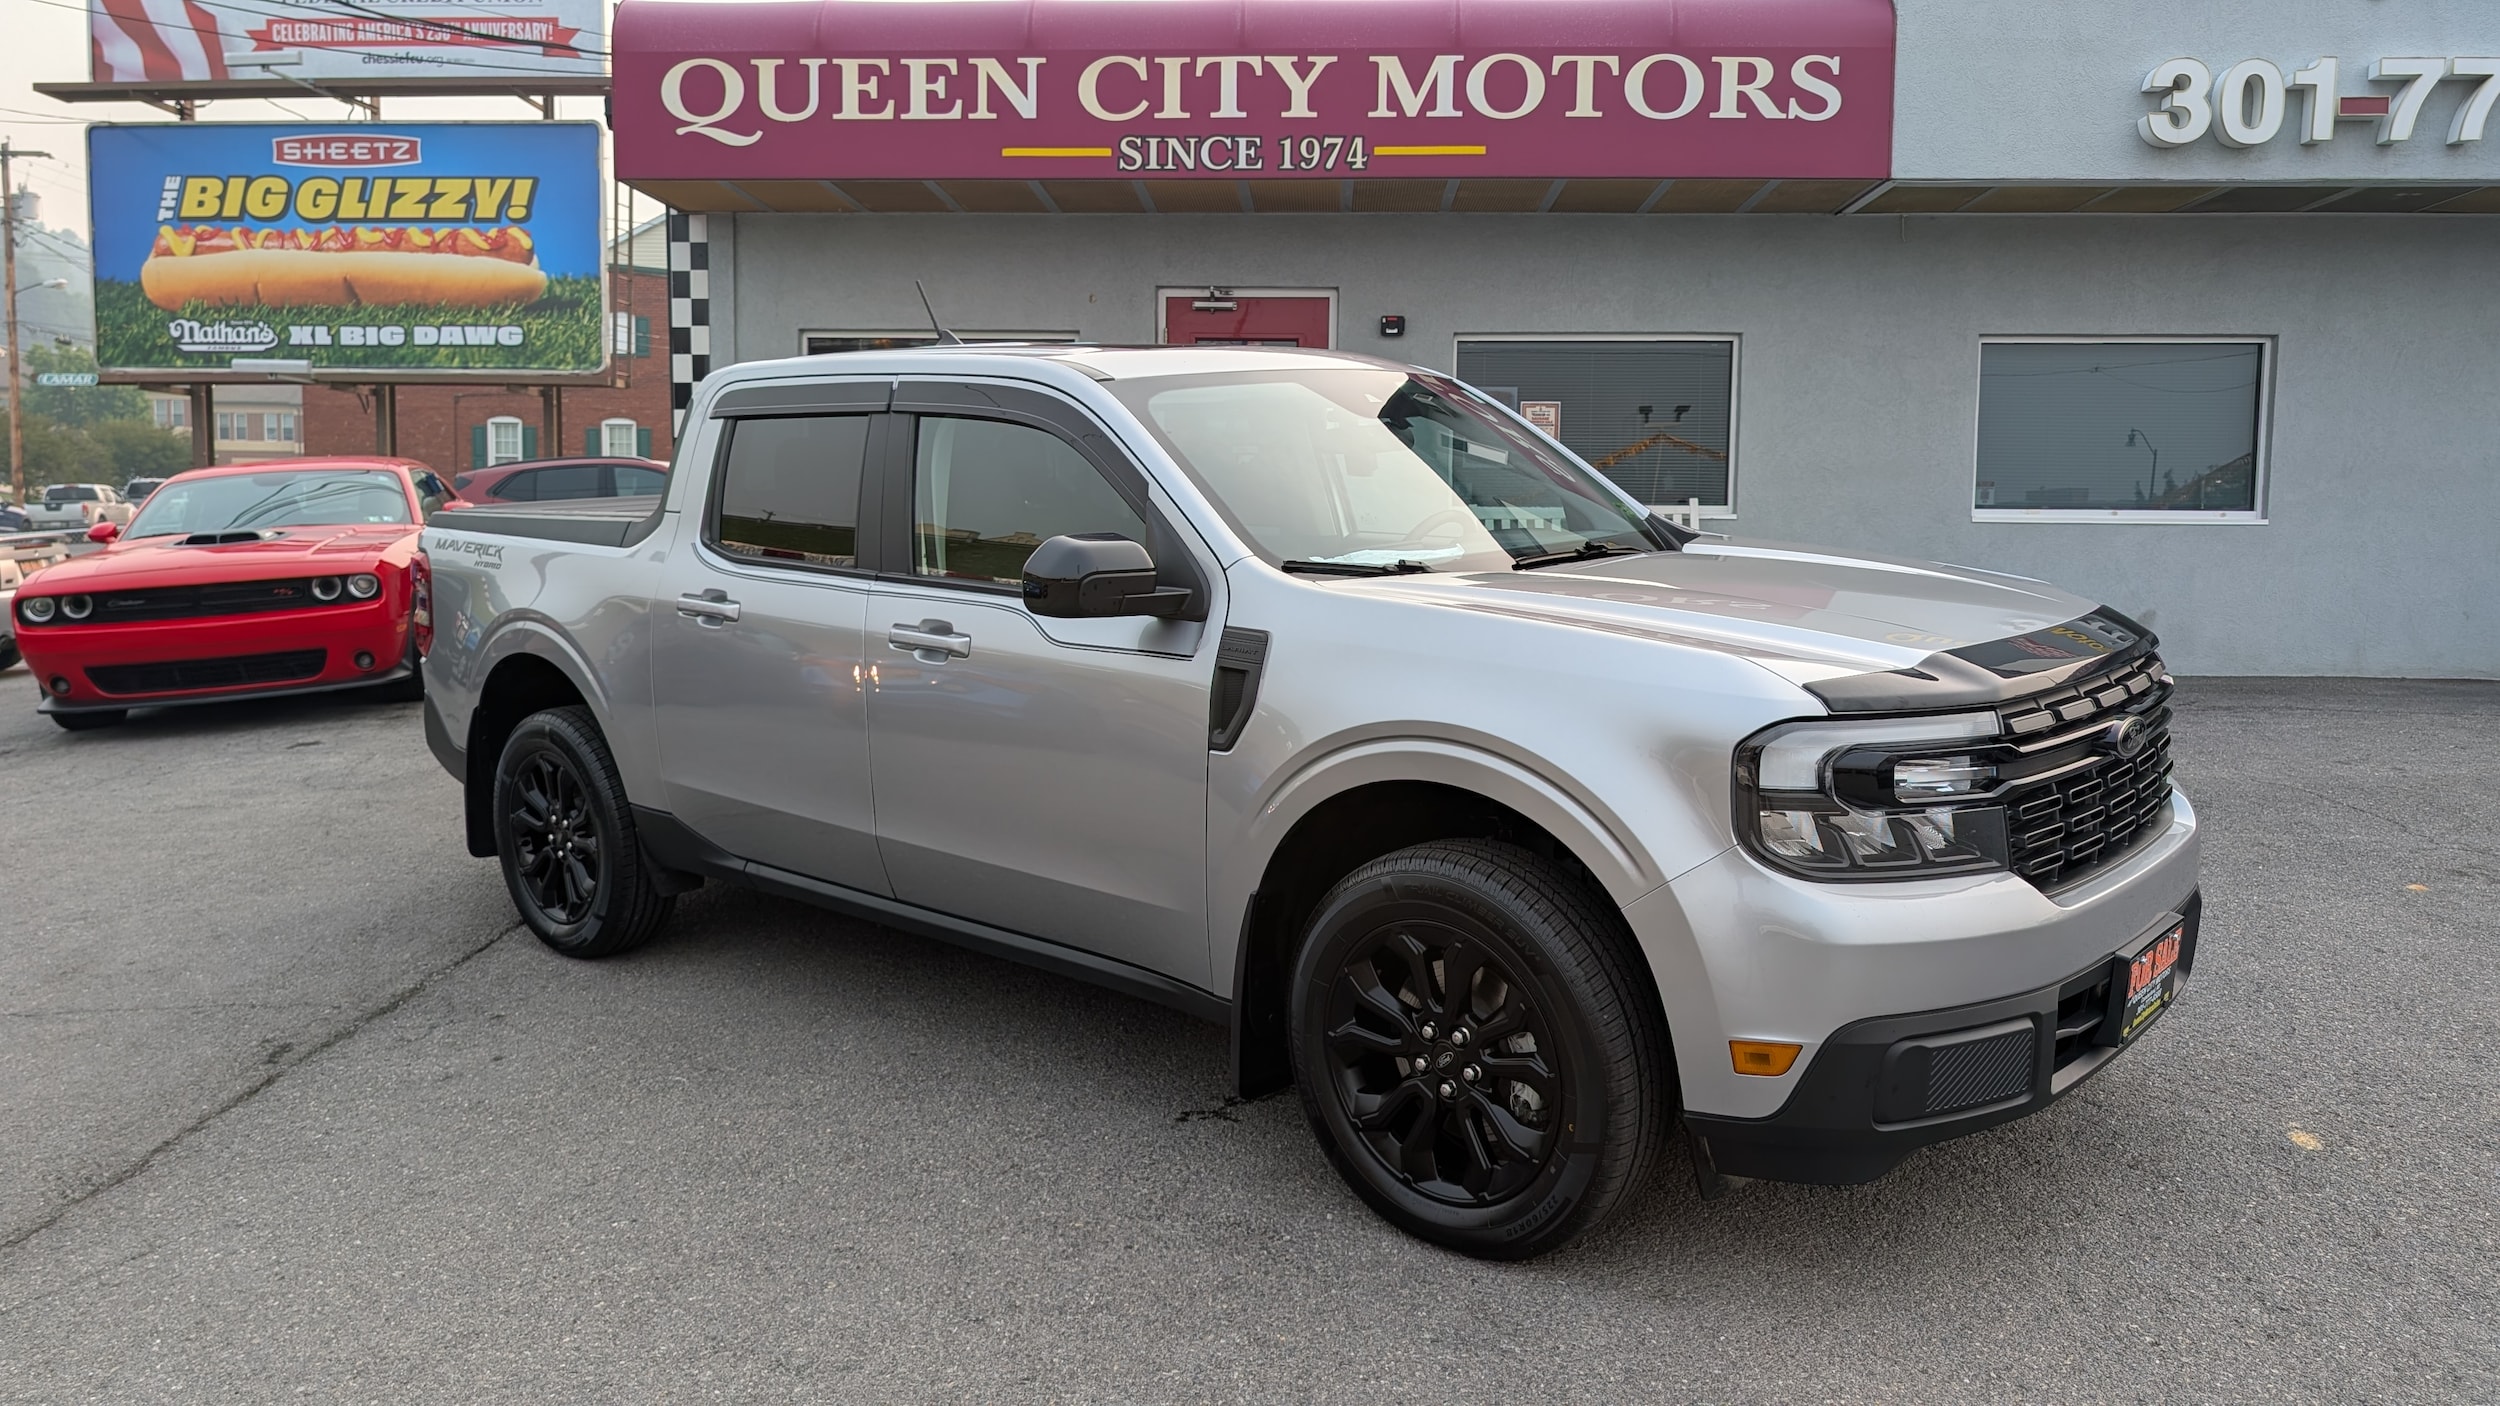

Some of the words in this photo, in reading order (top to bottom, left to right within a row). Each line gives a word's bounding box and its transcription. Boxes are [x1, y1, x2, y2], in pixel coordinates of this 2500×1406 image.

[272, 23, 354, 42] CELEBRATING
[660, 56, 1047, 147] QUEEN
[1077, 55, 1339, 122] CITY
[1367, 53, 1843, 122] MOTORS
[2137, 56, 2500, 148] 301-77
[282, 142, 412, 161] SHEETZ
[1117, 134, 1263, 171] SINCE
[1277, 134, 1369, 170] 1974
[156, 175, 182, 221] THE
[177, 175, 289, 219] BIG
[294, 175, 537, 221] GLIZZY!
[169, 319, 278, 345] Nathan's
[287, 325, 333, 346] XL
[338, 325, 406, 346] BIG
[412, 325, 525, 346] DAWG
[434, 538, 505, 562] MAVERICK
[473, 560, 502, 570] HYBRID
